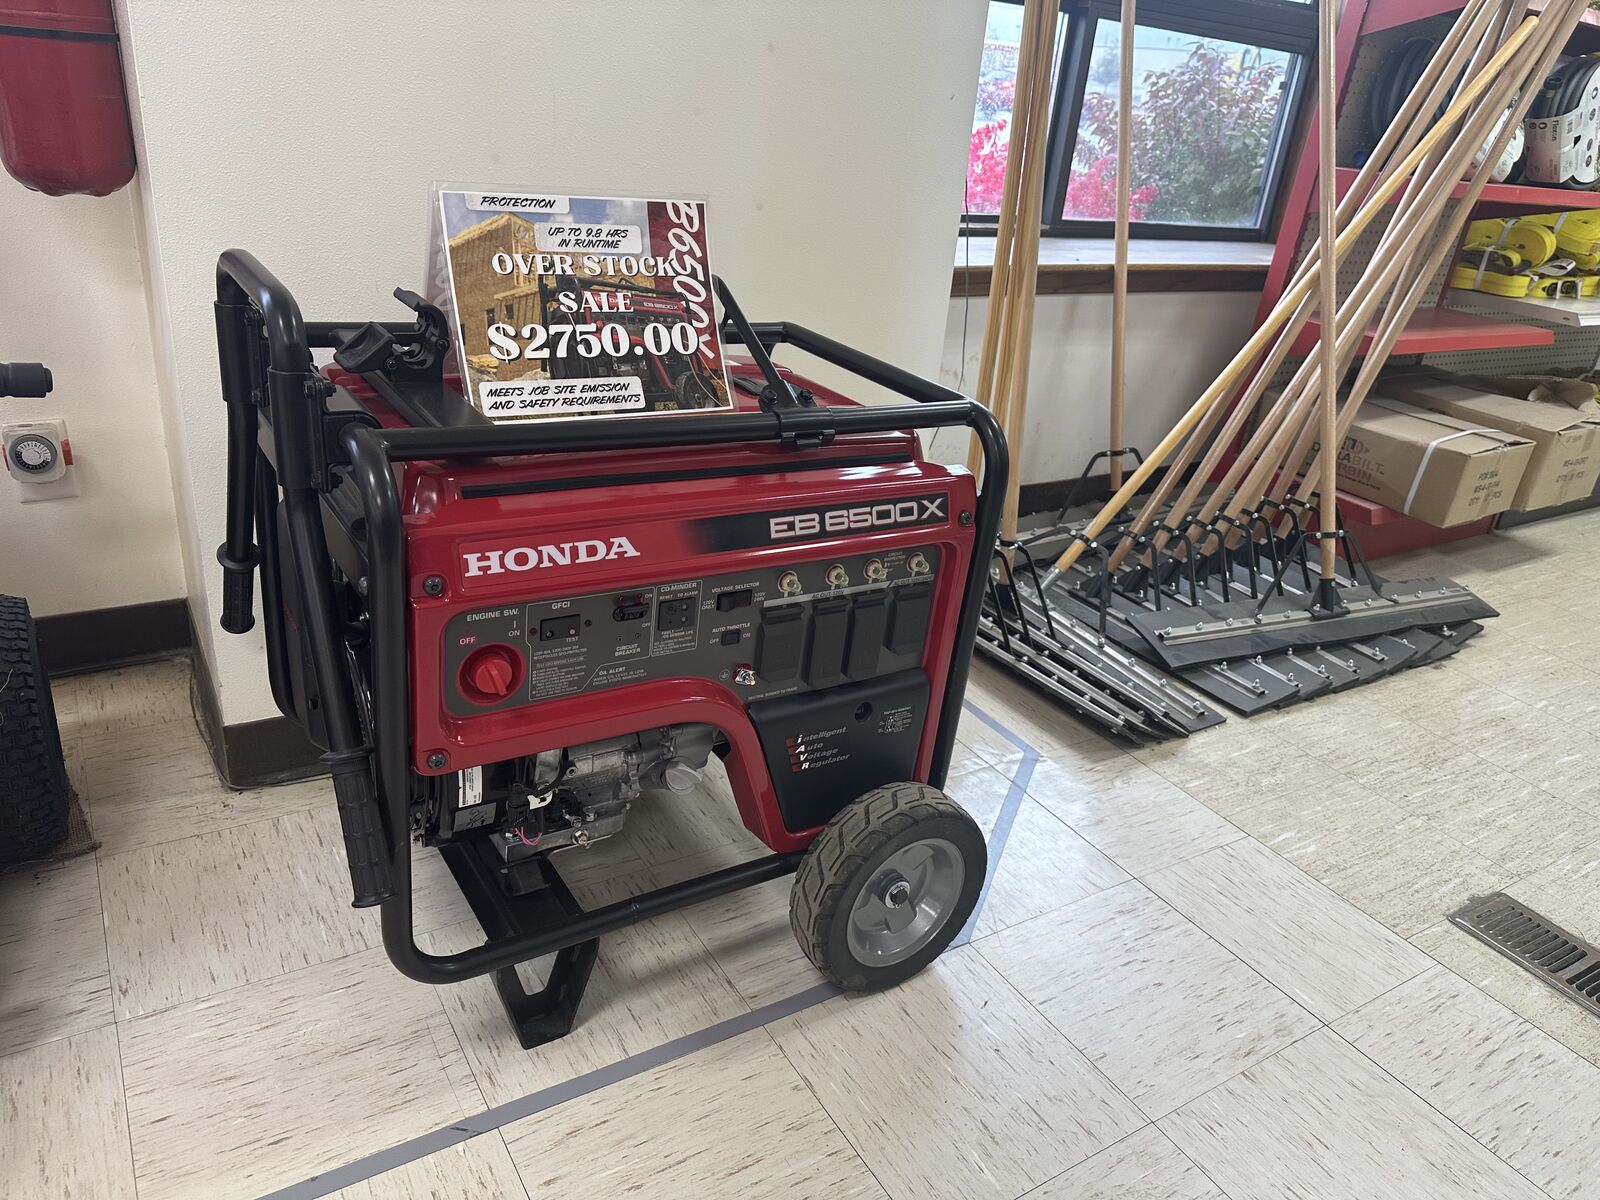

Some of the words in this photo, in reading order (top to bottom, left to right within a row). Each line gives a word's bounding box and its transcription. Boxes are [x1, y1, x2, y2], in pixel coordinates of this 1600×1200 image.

[480, 196, 556, 209] PROTECTION
[548, 226, 564, 237] UP
[568, 228, 582, 238] TO
[586, 228, 602, 238] 9.8
[606, 228, 629, 238] HRS
[558, 238, 570, 248] IN
[573, 239, 622, 249] RUNTIME
[492, 252, 576, 276] OVER
[582, 254, 678, 278] STOCK
[558, 292, 634, 314] SALE
[487, 321, 700, 364] $2750.00
[486, 386, 524, 398] MEETS
[528, 386, 551, 396] JOB
[554, 384, 577, 394] SITE
[580, 382, 631, 394] EMISSION
[488, 400, 514, 410] AND
[519, 398, 560, 409] SAFETY
[562, 394, 641, 407] REQUIREMENTS
[824, 498, 946, 532] 6500X
[463, 536, 640, 578] HONDA
[660, 582, 697, 592] CO-MINDER
[734, 582, 760, 590] SELECTOR
[551, 601, 571, 610] GFCI
[466, 610, 501, 622] ENGINE
[504, 608, 520, 616] SW.
[726, 622, 751, 630] THROTTLE
[460, 636, 476, 645] OFF
[614, 648, 641, 656] BREAKER
[616, 644, 638, 652] CIRCUIT
[797, 726, 846, 744] intelligent
[795, 742, 824, 754] Auto
[800, 748, 838, 761] Voltage
[801, 754, 850, 770] Regulator
